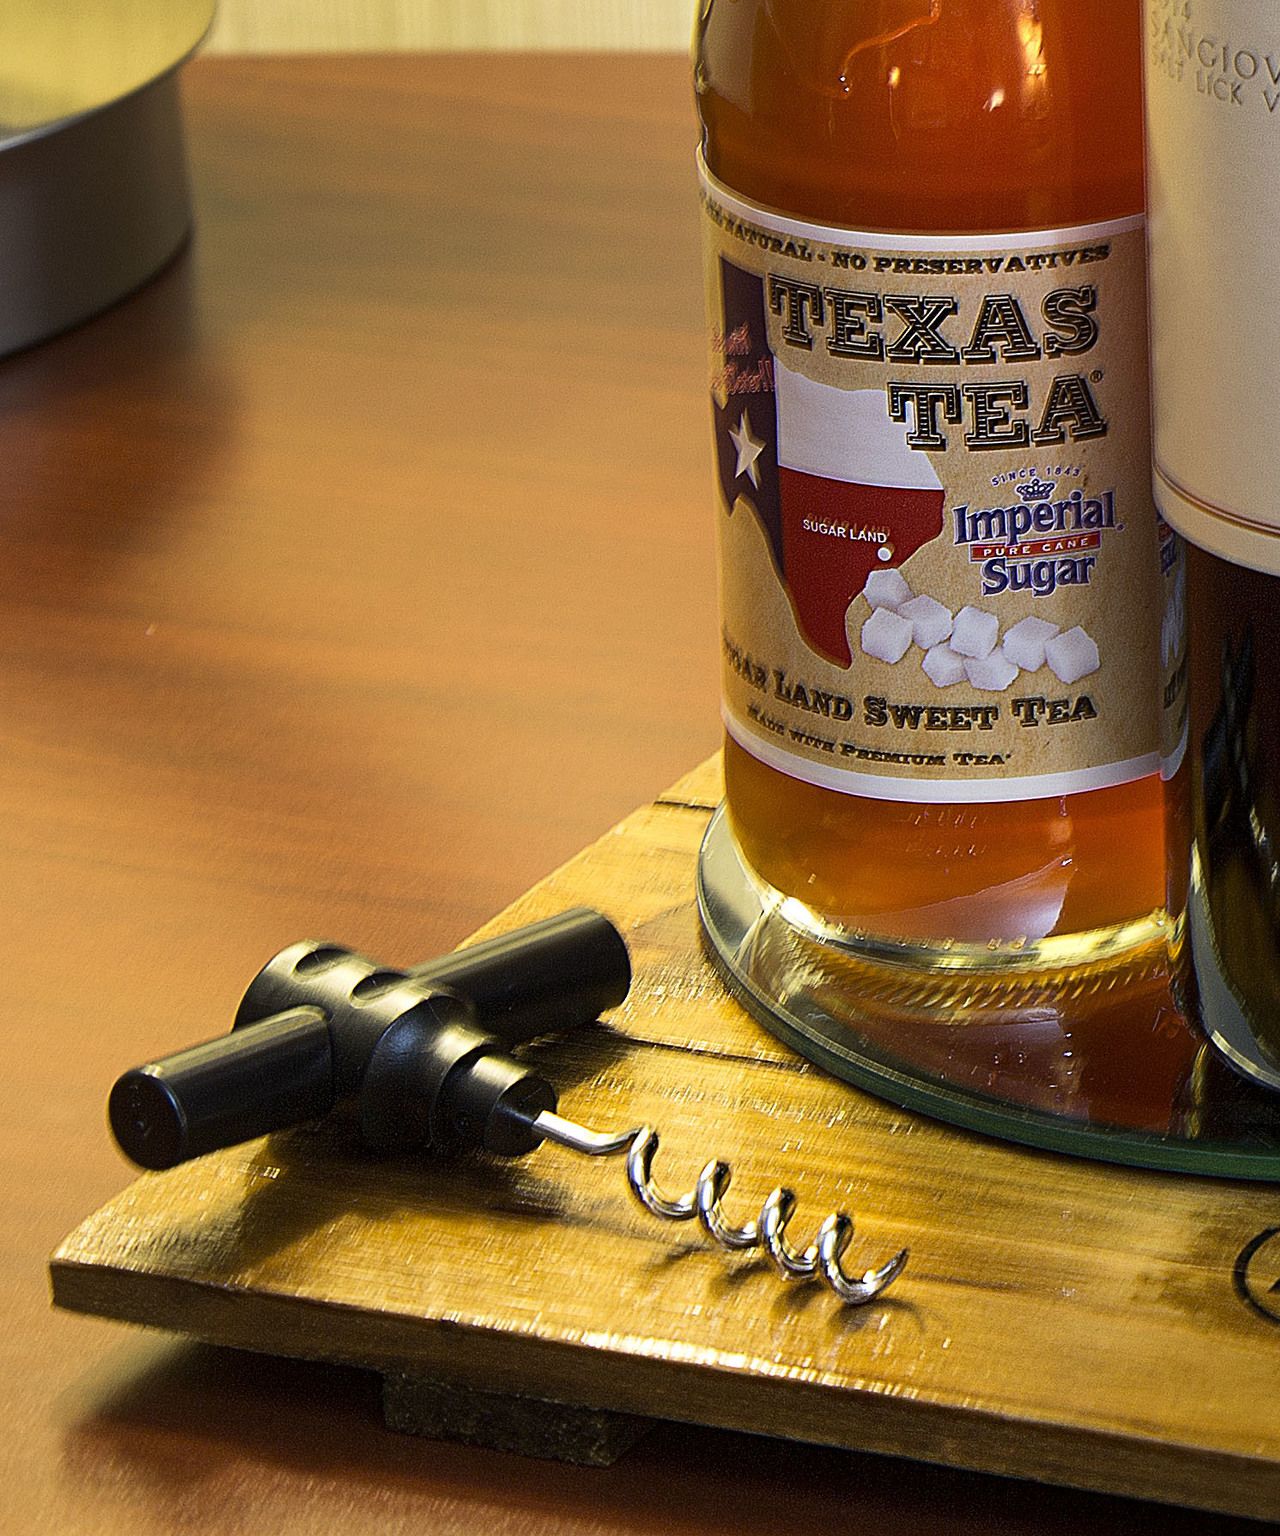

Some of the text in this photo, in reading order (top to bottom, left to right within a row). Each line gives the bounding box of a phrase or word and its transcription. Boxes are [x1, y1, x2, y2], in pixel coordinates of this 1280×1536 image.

[1196, 70, 1243, 105] LICK
[724, 216, 813, 262] NATURAL
[831, 251, 867, 271] NO
[873, 245, 1110, 275] PRESERVATIVES
[767, 272, 1099, 364] TEXAS
[885, 370, 1107, 453] TEA
[990, 465, 1081, 487] SINCE 1843
[802, 519, 888, 544] SUGAR LAND
[952, 490, 1116, 547] Imperial
[983, 537, 1089, 557] PURE CANE
[981, 556, 1096, 598] Sugar
[772, 667, 853, 722] LAND
[862, 693, 999, 731] SWEET
[1011, 693, 1098, 727] TEA
[788, 728, 835, 753] WITH
[839, 741, 946, 766] PREMIUM
